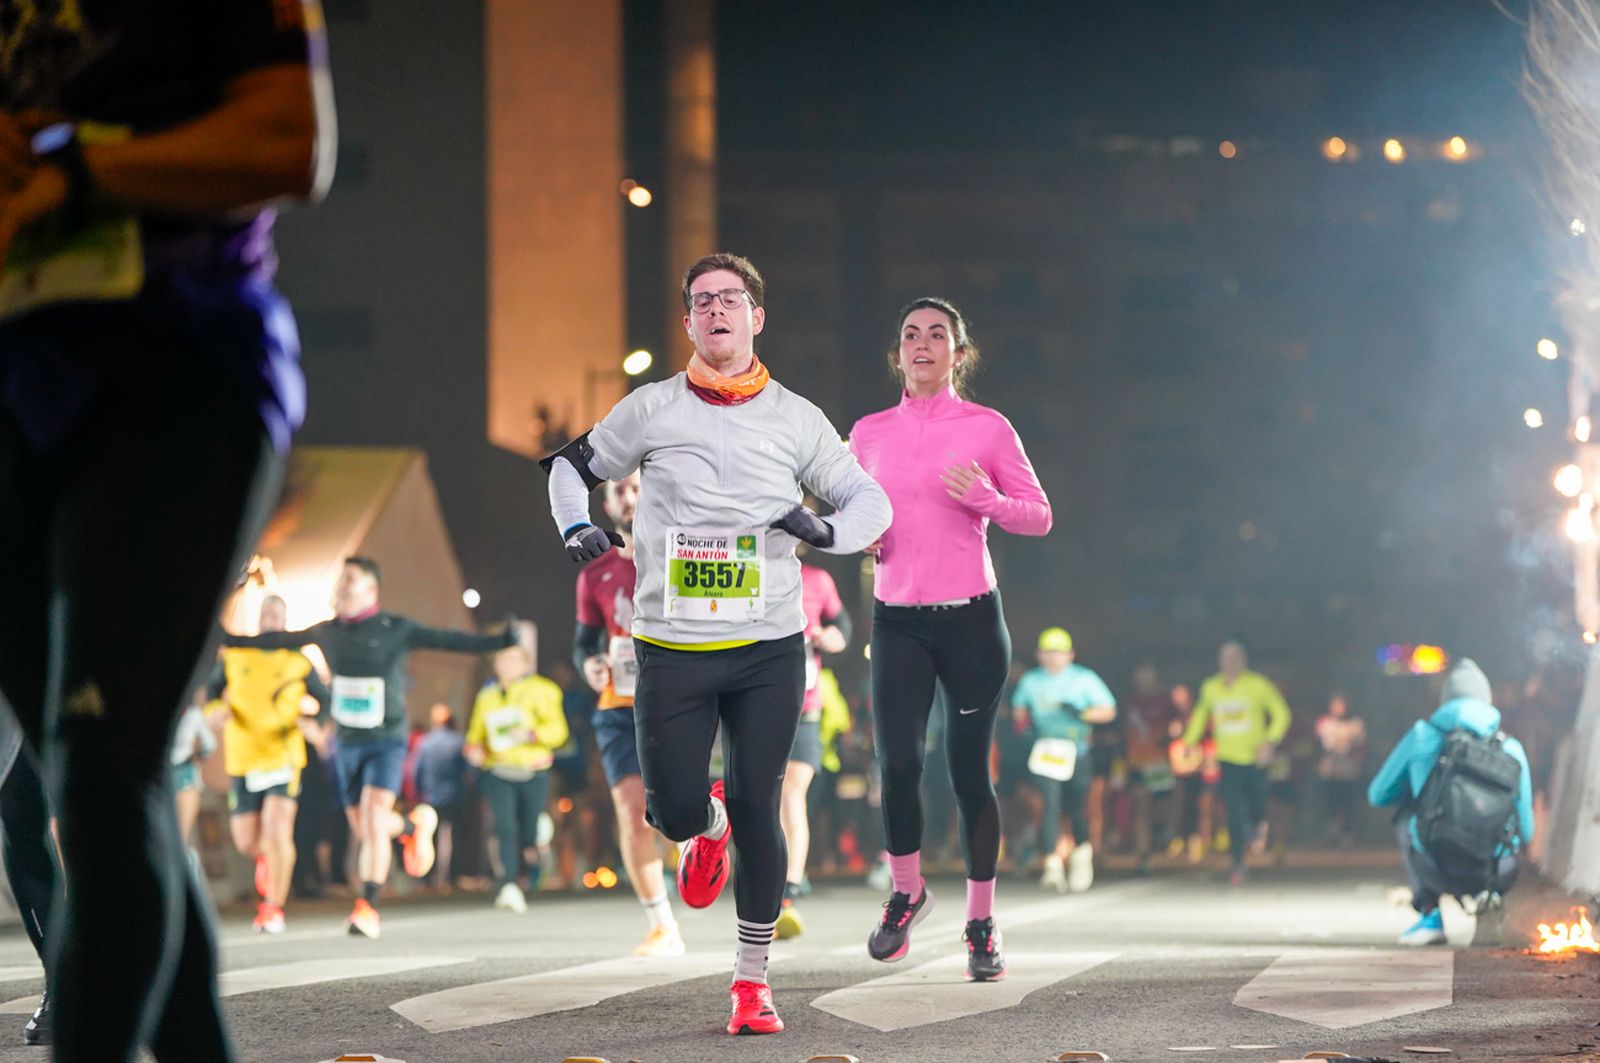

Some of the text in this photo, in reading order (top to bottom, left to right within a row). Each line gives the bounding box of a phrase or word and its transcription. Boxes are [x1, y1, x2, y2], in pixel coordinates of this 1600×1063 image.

[687, 540, 728, 549] NOCHE DE
[677, 549, 694, 559] SAN
[695, 548, 728, 560] ANTÓN
[684, 561, 746, 589] 3557
